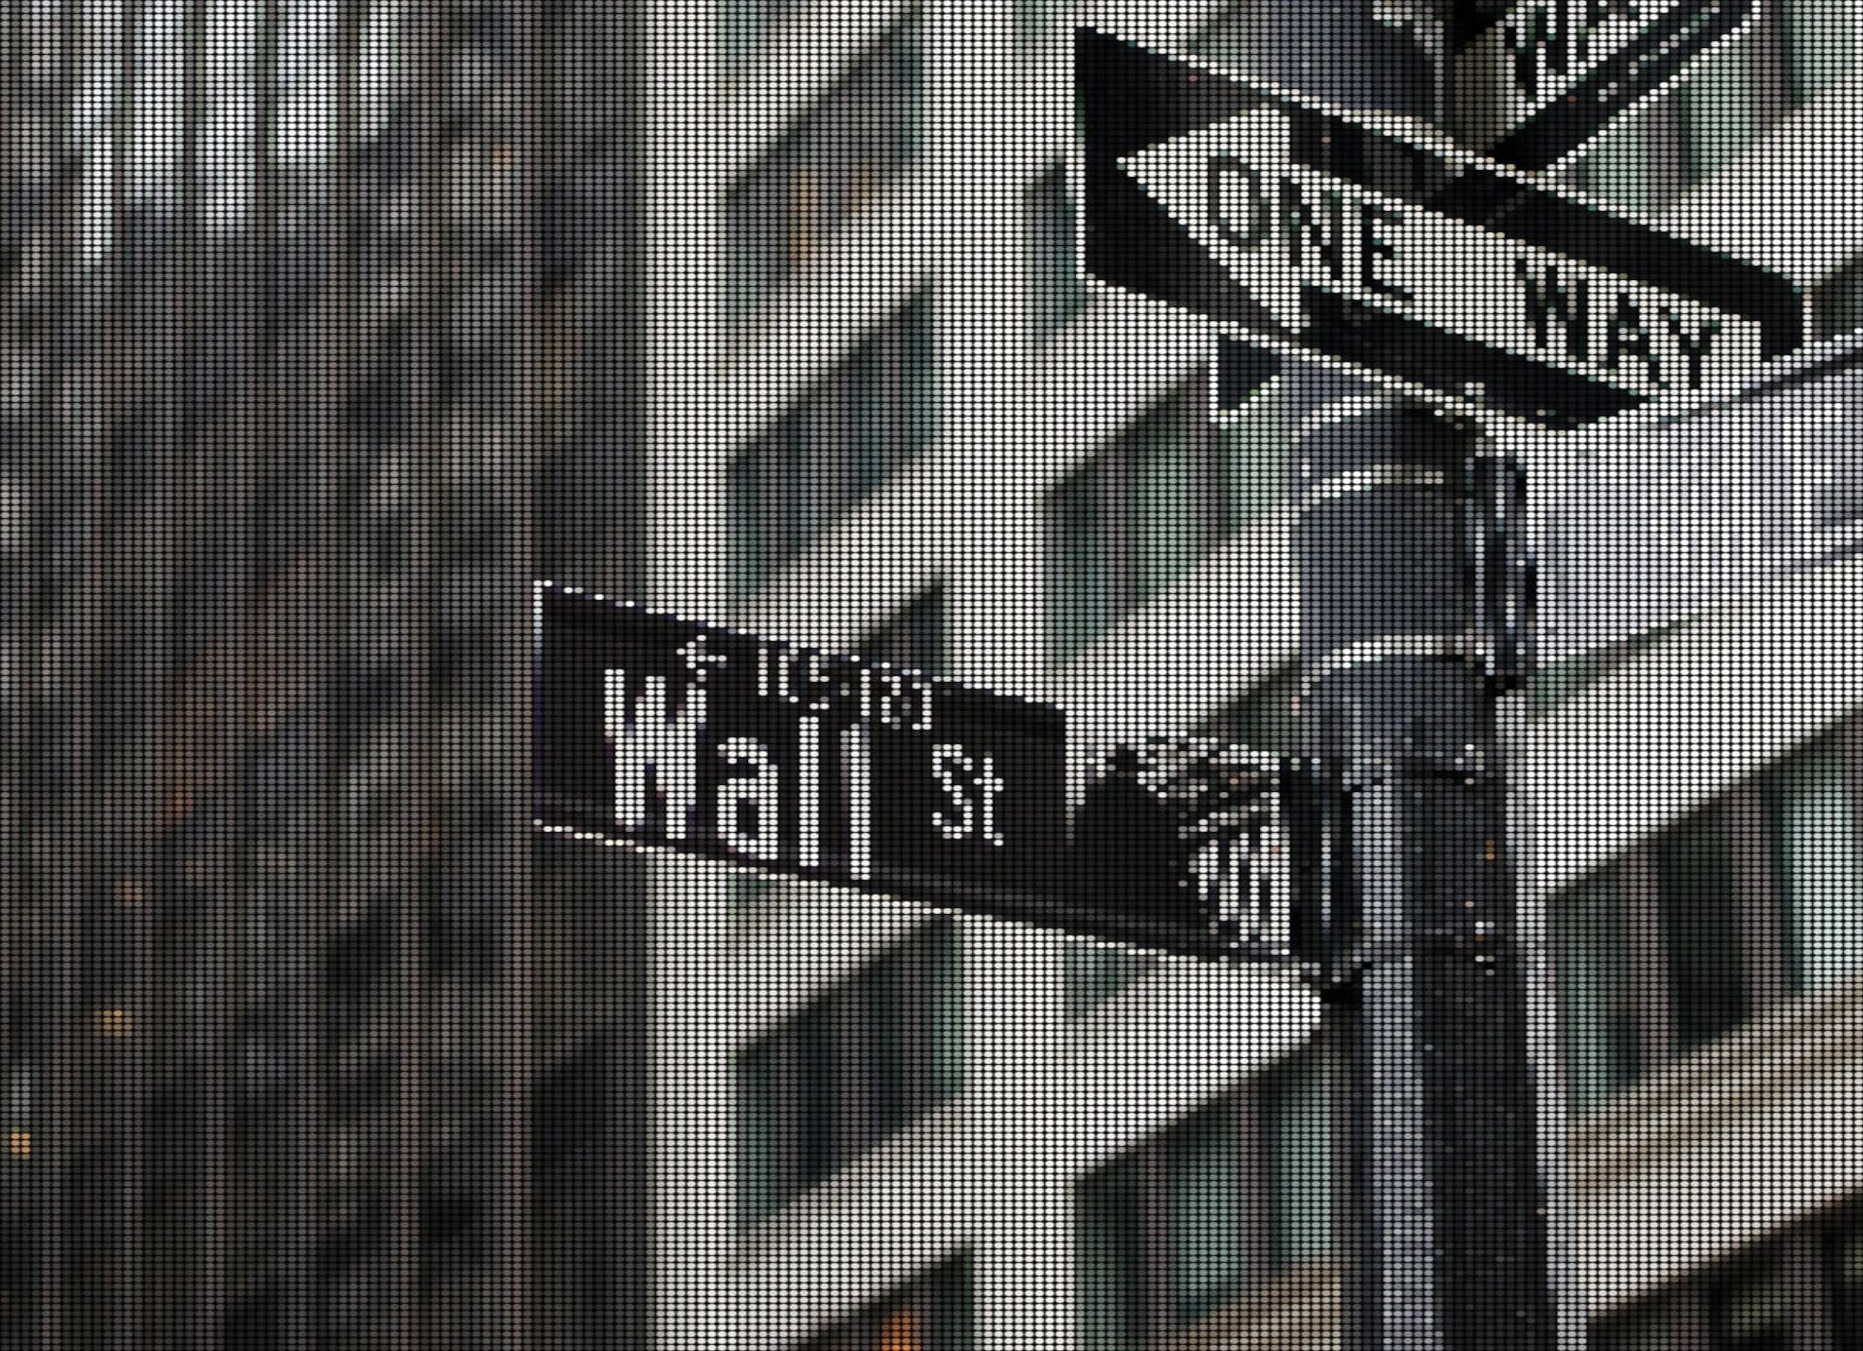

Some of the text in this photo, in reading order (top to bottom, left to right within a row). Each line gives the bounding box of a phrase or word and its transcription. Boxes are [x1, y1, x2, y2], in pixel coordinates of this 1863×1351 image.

[1208, 152, 1722, 392] ONE WAY
[604, 667, 1004, 881] Wall St
